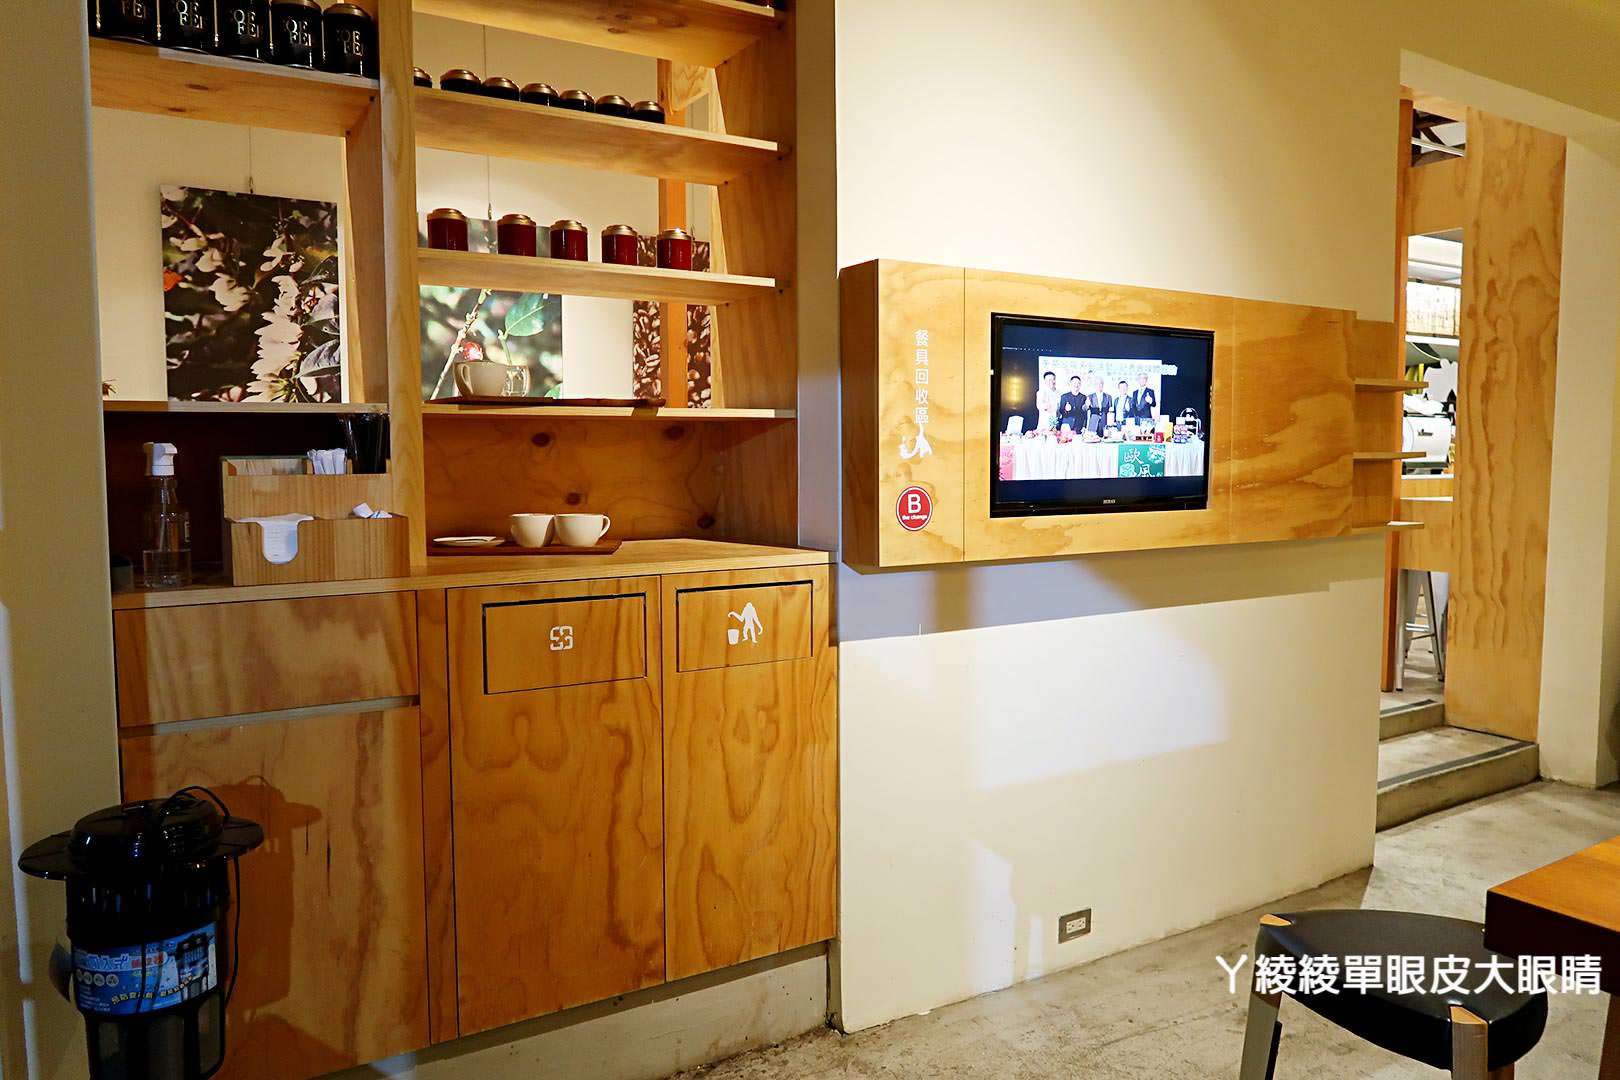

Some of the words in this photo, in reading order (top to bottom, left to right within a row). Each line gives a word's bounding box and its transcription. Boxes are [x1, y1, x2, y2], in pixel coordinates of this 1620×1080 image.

[915, 329, 928, 424] 餐具回收區
[907, 493, 922, 514] B
